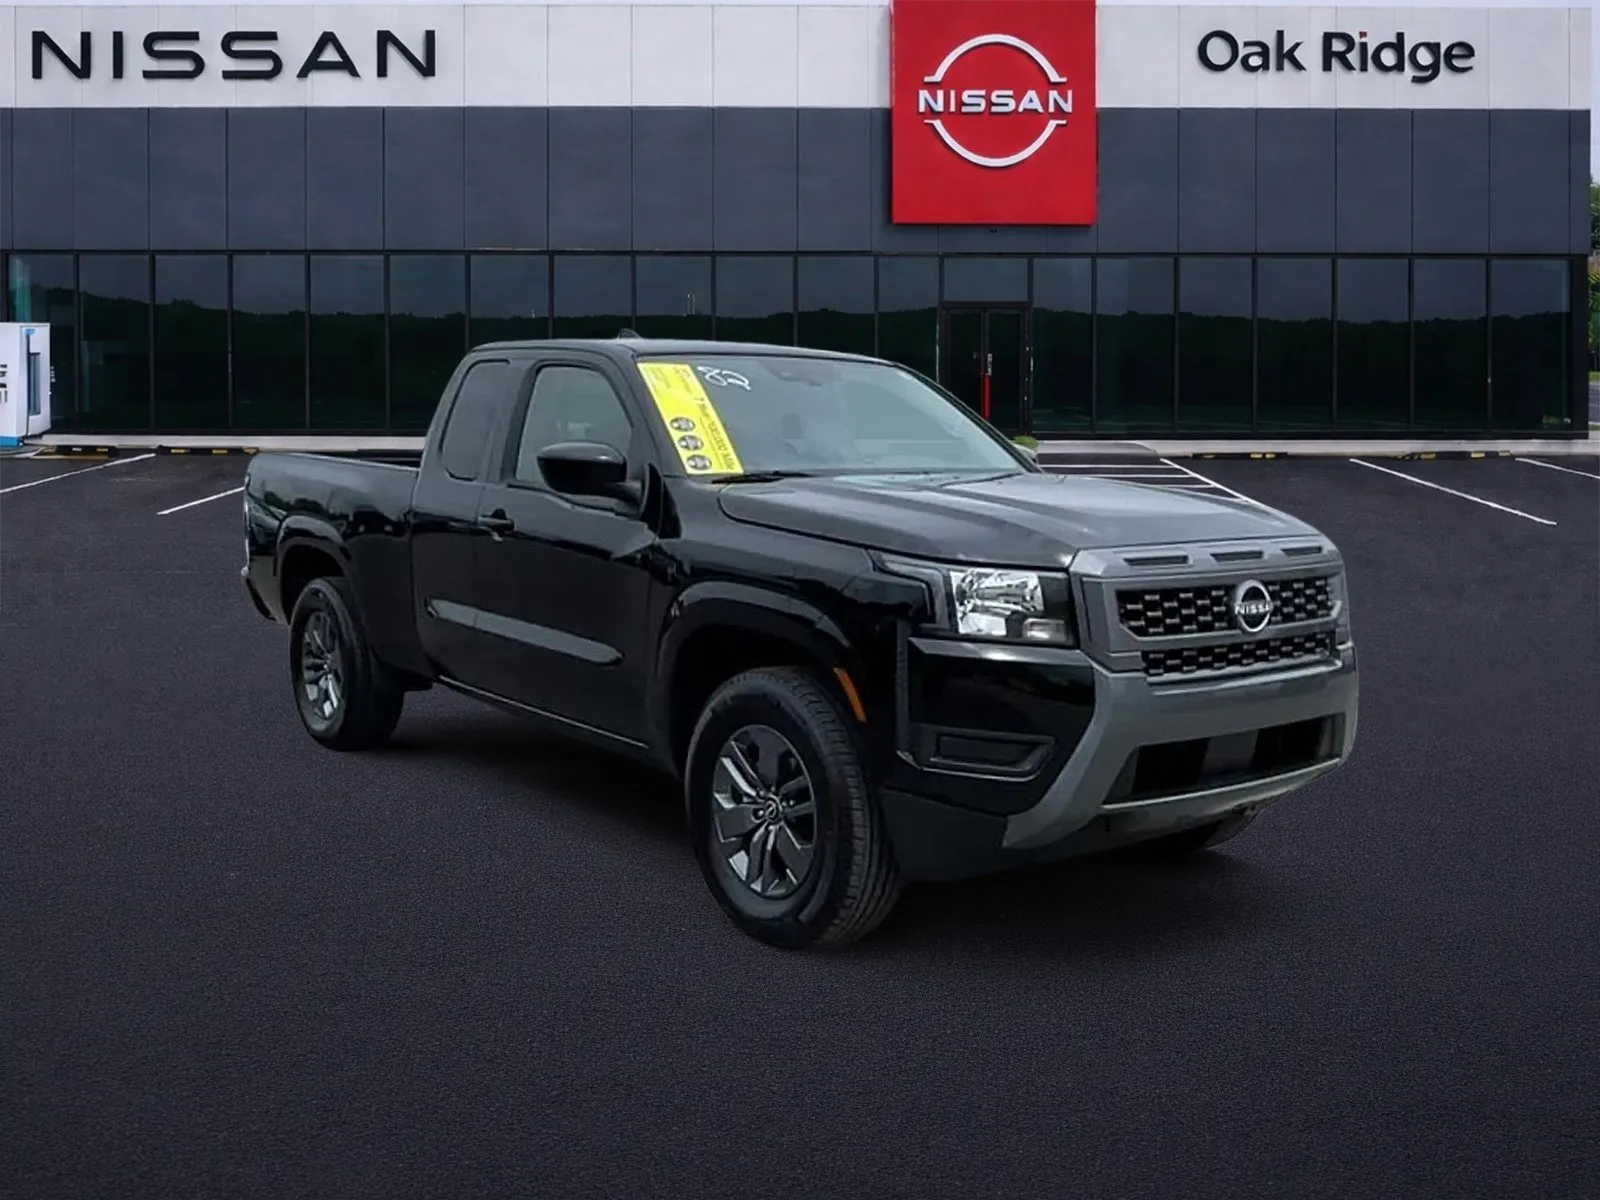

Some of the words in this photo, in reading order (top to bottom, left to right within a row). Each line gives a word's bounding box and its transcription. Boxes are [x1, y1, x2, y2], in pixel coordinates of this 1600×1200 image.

[31, 29, 436, 81] NISSAN
[1197, 29, 1307, 74] Oak
[1321, 30, 1477, 85] Ridge
[917, 88, 1074, 114] NISSAN
